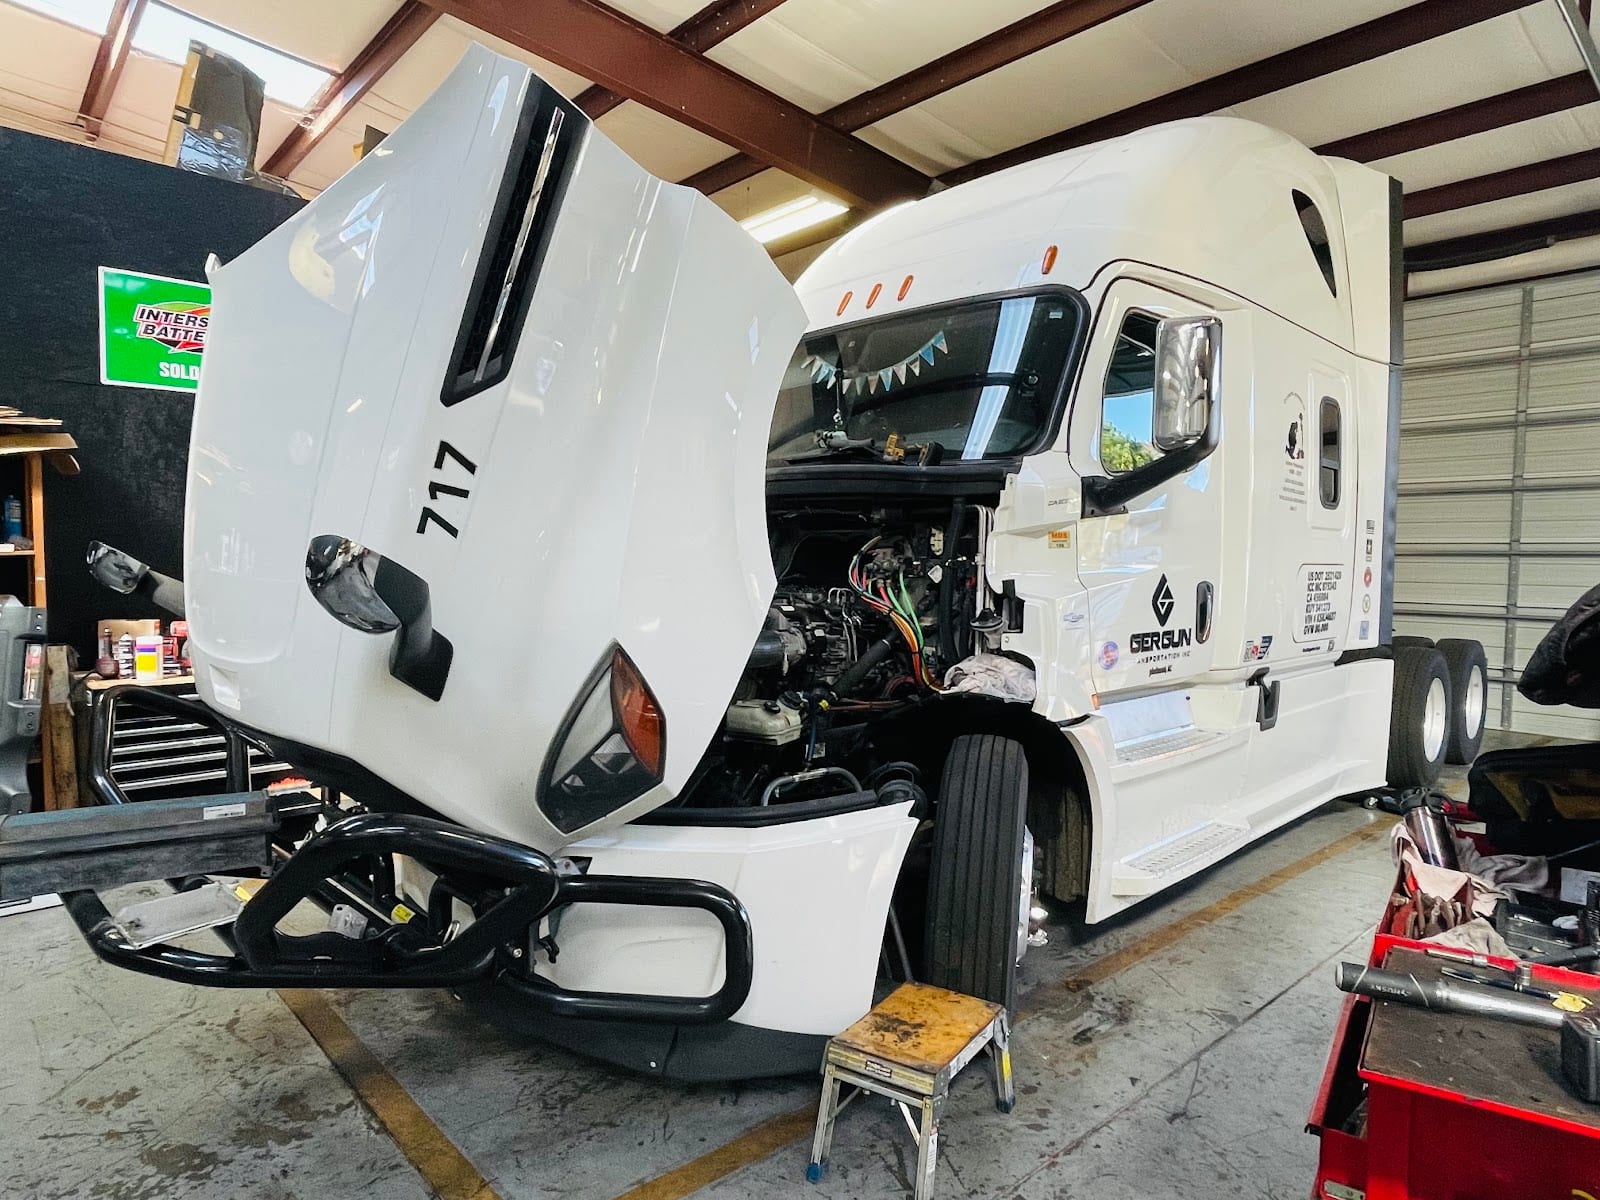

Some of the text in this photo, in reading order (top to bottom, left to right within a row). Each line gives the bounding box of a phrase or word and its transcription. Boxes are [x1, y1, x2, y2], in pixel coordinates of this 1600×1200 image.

[139, 308, 209, 328] INTERS
[143, 324, 206, 342] BATTE
[159, 361, 200, 380] SOLD
[416, 440, 478, 539] 717
[1315, 571, 1324, 581] DOT
[1130, 628, 1192, 654] GERGUN
